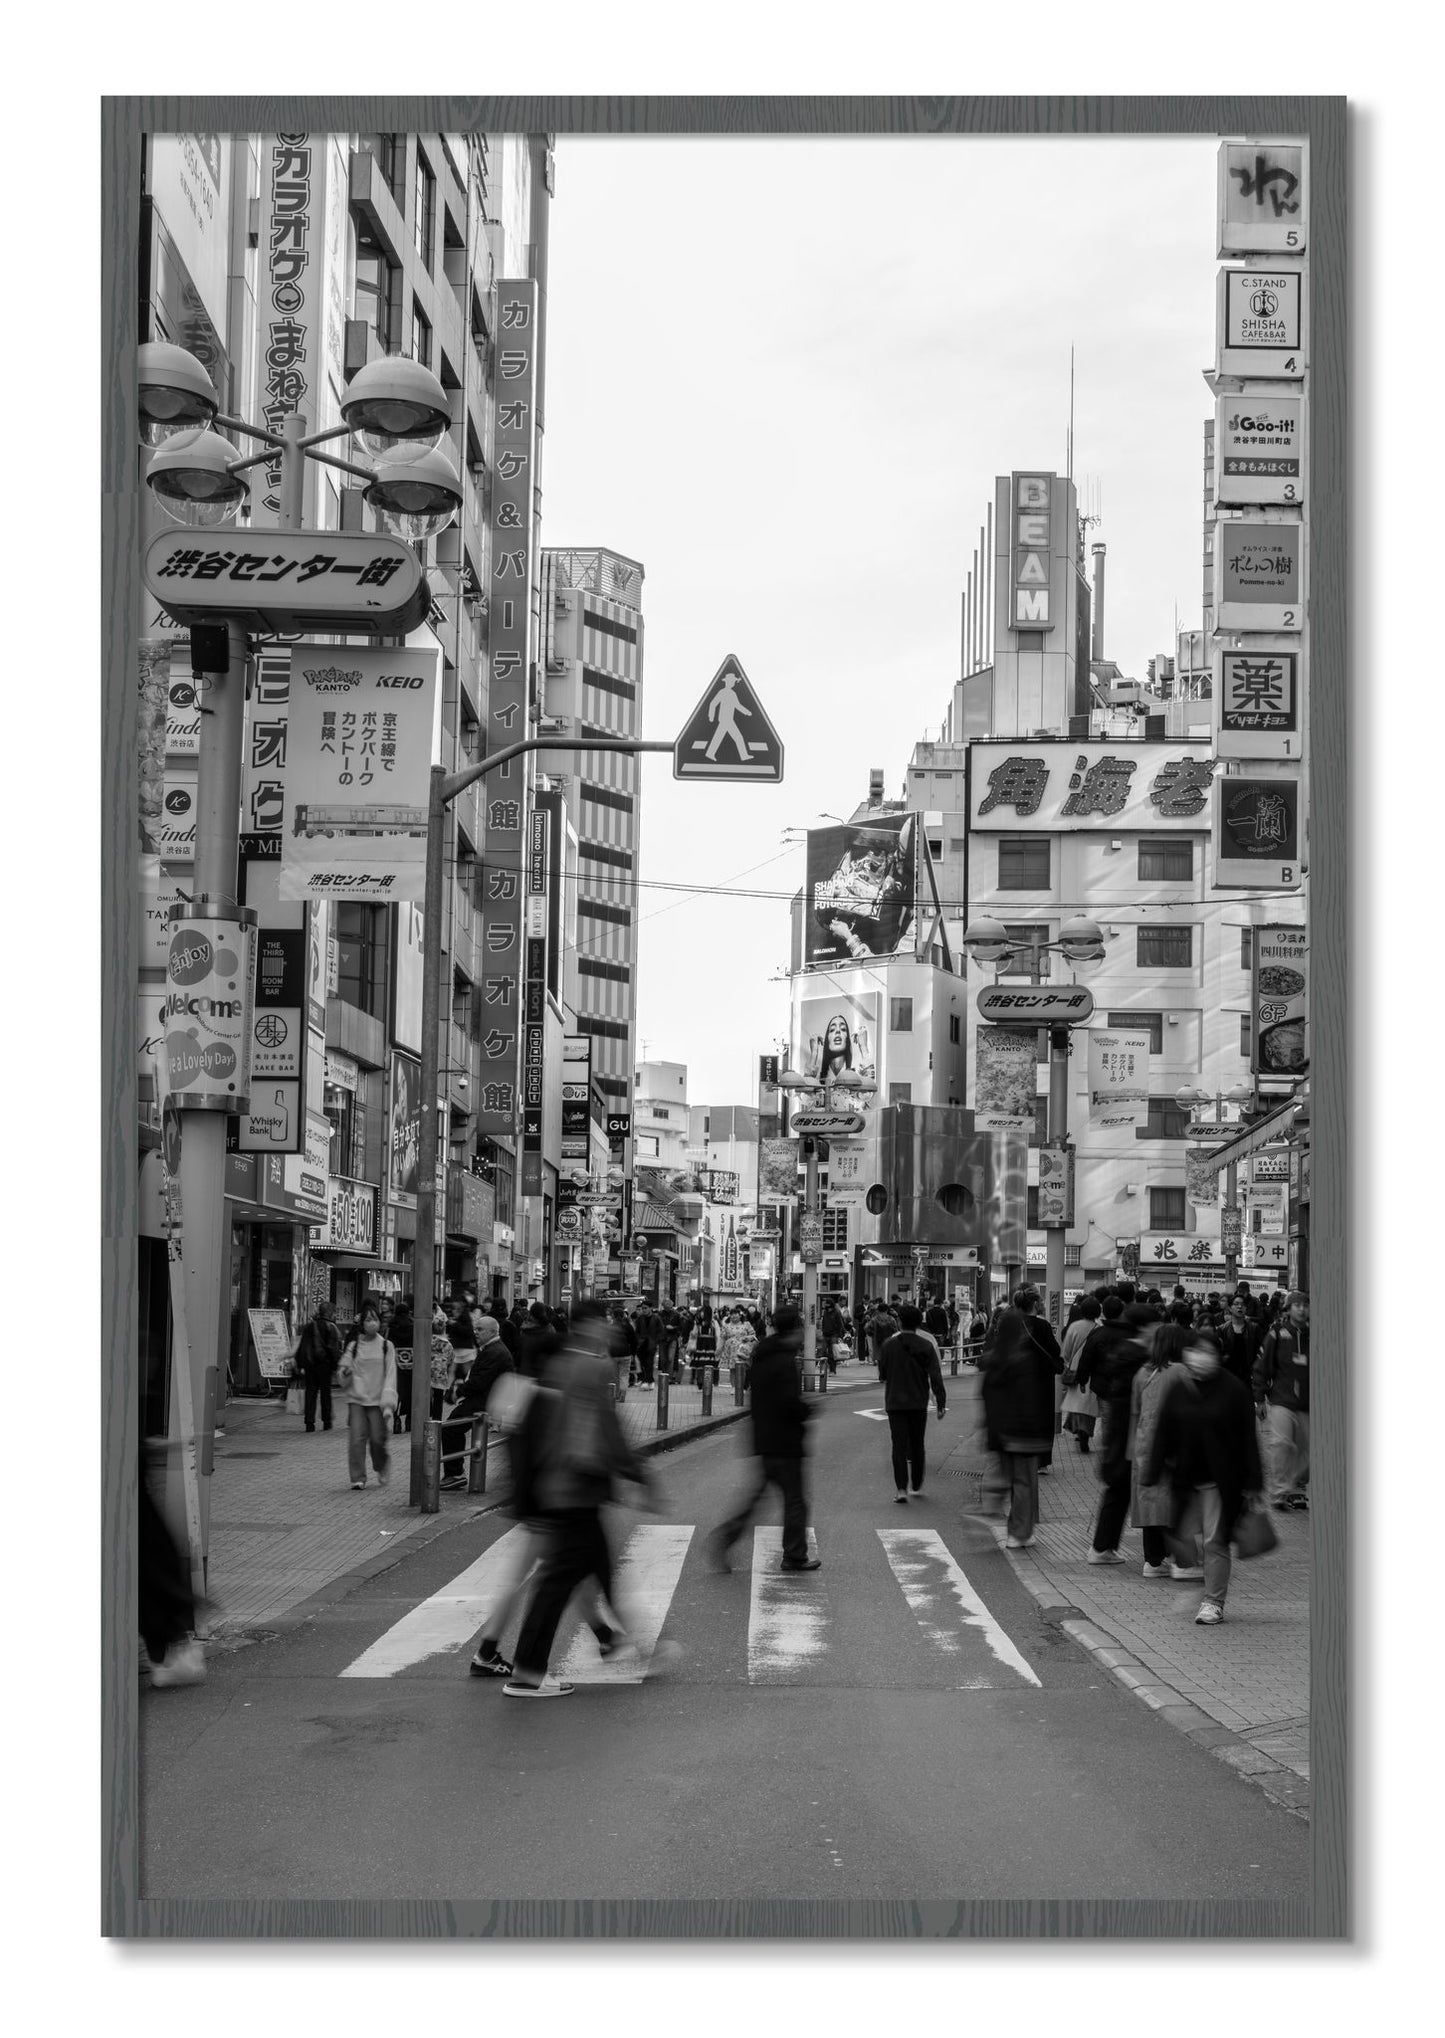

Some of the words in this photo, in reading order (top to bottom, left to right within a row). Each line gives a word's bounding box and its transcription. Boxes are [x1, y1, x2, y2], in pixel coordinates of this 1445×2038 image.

[270, 146, 312, 284] カラオケ
[1286, 231, 1298, 247] 5
[1241, 278, 1287, 288] C.STAND
[1241, 319, 1286, 330] SHISHA
[1241, 330, 1286, 339] CAFE&BAR
[1284, 356, 1297, 373] 4
[1240, 416, 1295, 432] Goo-it!
[1233, 436, 1292, 445] 渋谷宇田川町店
[1228, 461, 1296, 473] 全身もみほぐし
[1283, 483, 1296, 501] 3
[1017, 477, 1050, 621] BEAM
[156, 549, 406, 587] 渋谷センター街
[1229, 555, 1293, 574] ポムの樹
[1239, 578, 1285, 586] Pomme-no-ki
[1283, 610, 1295, 627] 2
[315, 684, 351, 692] KANTO
[375, 676, 424, 690] KEIO
[1232, 659, 1283, 711] 薬
[1226, 713, 1288, 728] マツモトキヨシ
[320, 711, 337, 754] 冒険へ
[169, 738, 195, 748] 渋谷店
[338, 711, 357, 786] カントーの
[359, 711, 377, 786] ポケパーク
[380, 712, 398, 772] 京王線で
[1282, 738, 1291, 755] 1
[977, 755, 1218, 817] 角海老
[165, 846, 191, 856] 渋谷店
[307, 873, 397, 887] 渋谷センター街
[1281, 866, 1293, 883] B
[262, 949, 284, 957] THIRD
[266, 941, 280, 949] THE
[169, 943, 209, 978] Enjoy
[262, 977, 283, 985] ROOM
[481, 869, 518, 1114] カラオケ館
[165, 992, 242, 1018] Welcome
[984, 994, 1087, 1008] 渋谷センター街
[1259, 1003, 1288, 1023] 6F
[183, 1050, 213, 1070] Lovely
[215, 1052, 235, 1066] Day!
[249, 1125, 270, 1134] Bank
[250, 1116, 283, 1128] Whisky
[609, 1120, 629, 1131] GU
[727, 1237, 736, 1280] BEER
